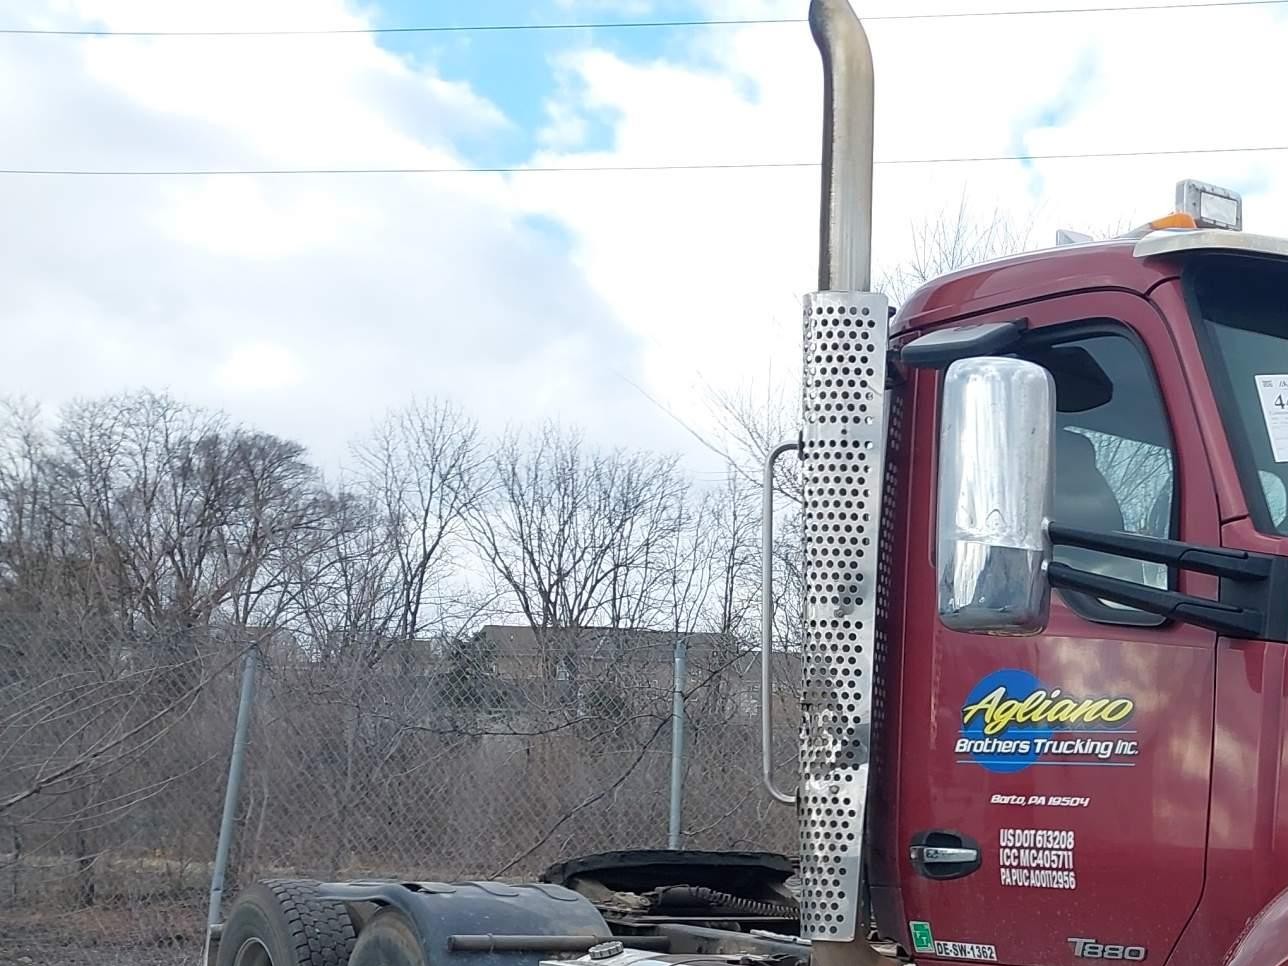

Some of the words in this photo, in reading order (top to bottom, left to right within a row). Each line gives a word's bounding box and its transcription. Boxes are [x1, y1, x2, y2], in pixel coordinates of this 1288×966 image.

[962, 686, 1134, 735] Agliano
[954, 738, 1030, 754] Brothers
[1034, 739, 1113, 758] Trucking
[1115, 741, 1139, 756] Inc.
[990, 794, 1026, 807] Barto,
[1027, 796, 1046, 806] PA
[1047, 796, 1090, 807] 19504
[1036, 830, 1075, 850] 613208
[1000, 848, 1019, 867] ICC
[1012, 869, 1030, 887] PUC
[937, 942, 995, 959] DE-SW-1362
[1068, 938, 1146, 961] T880
